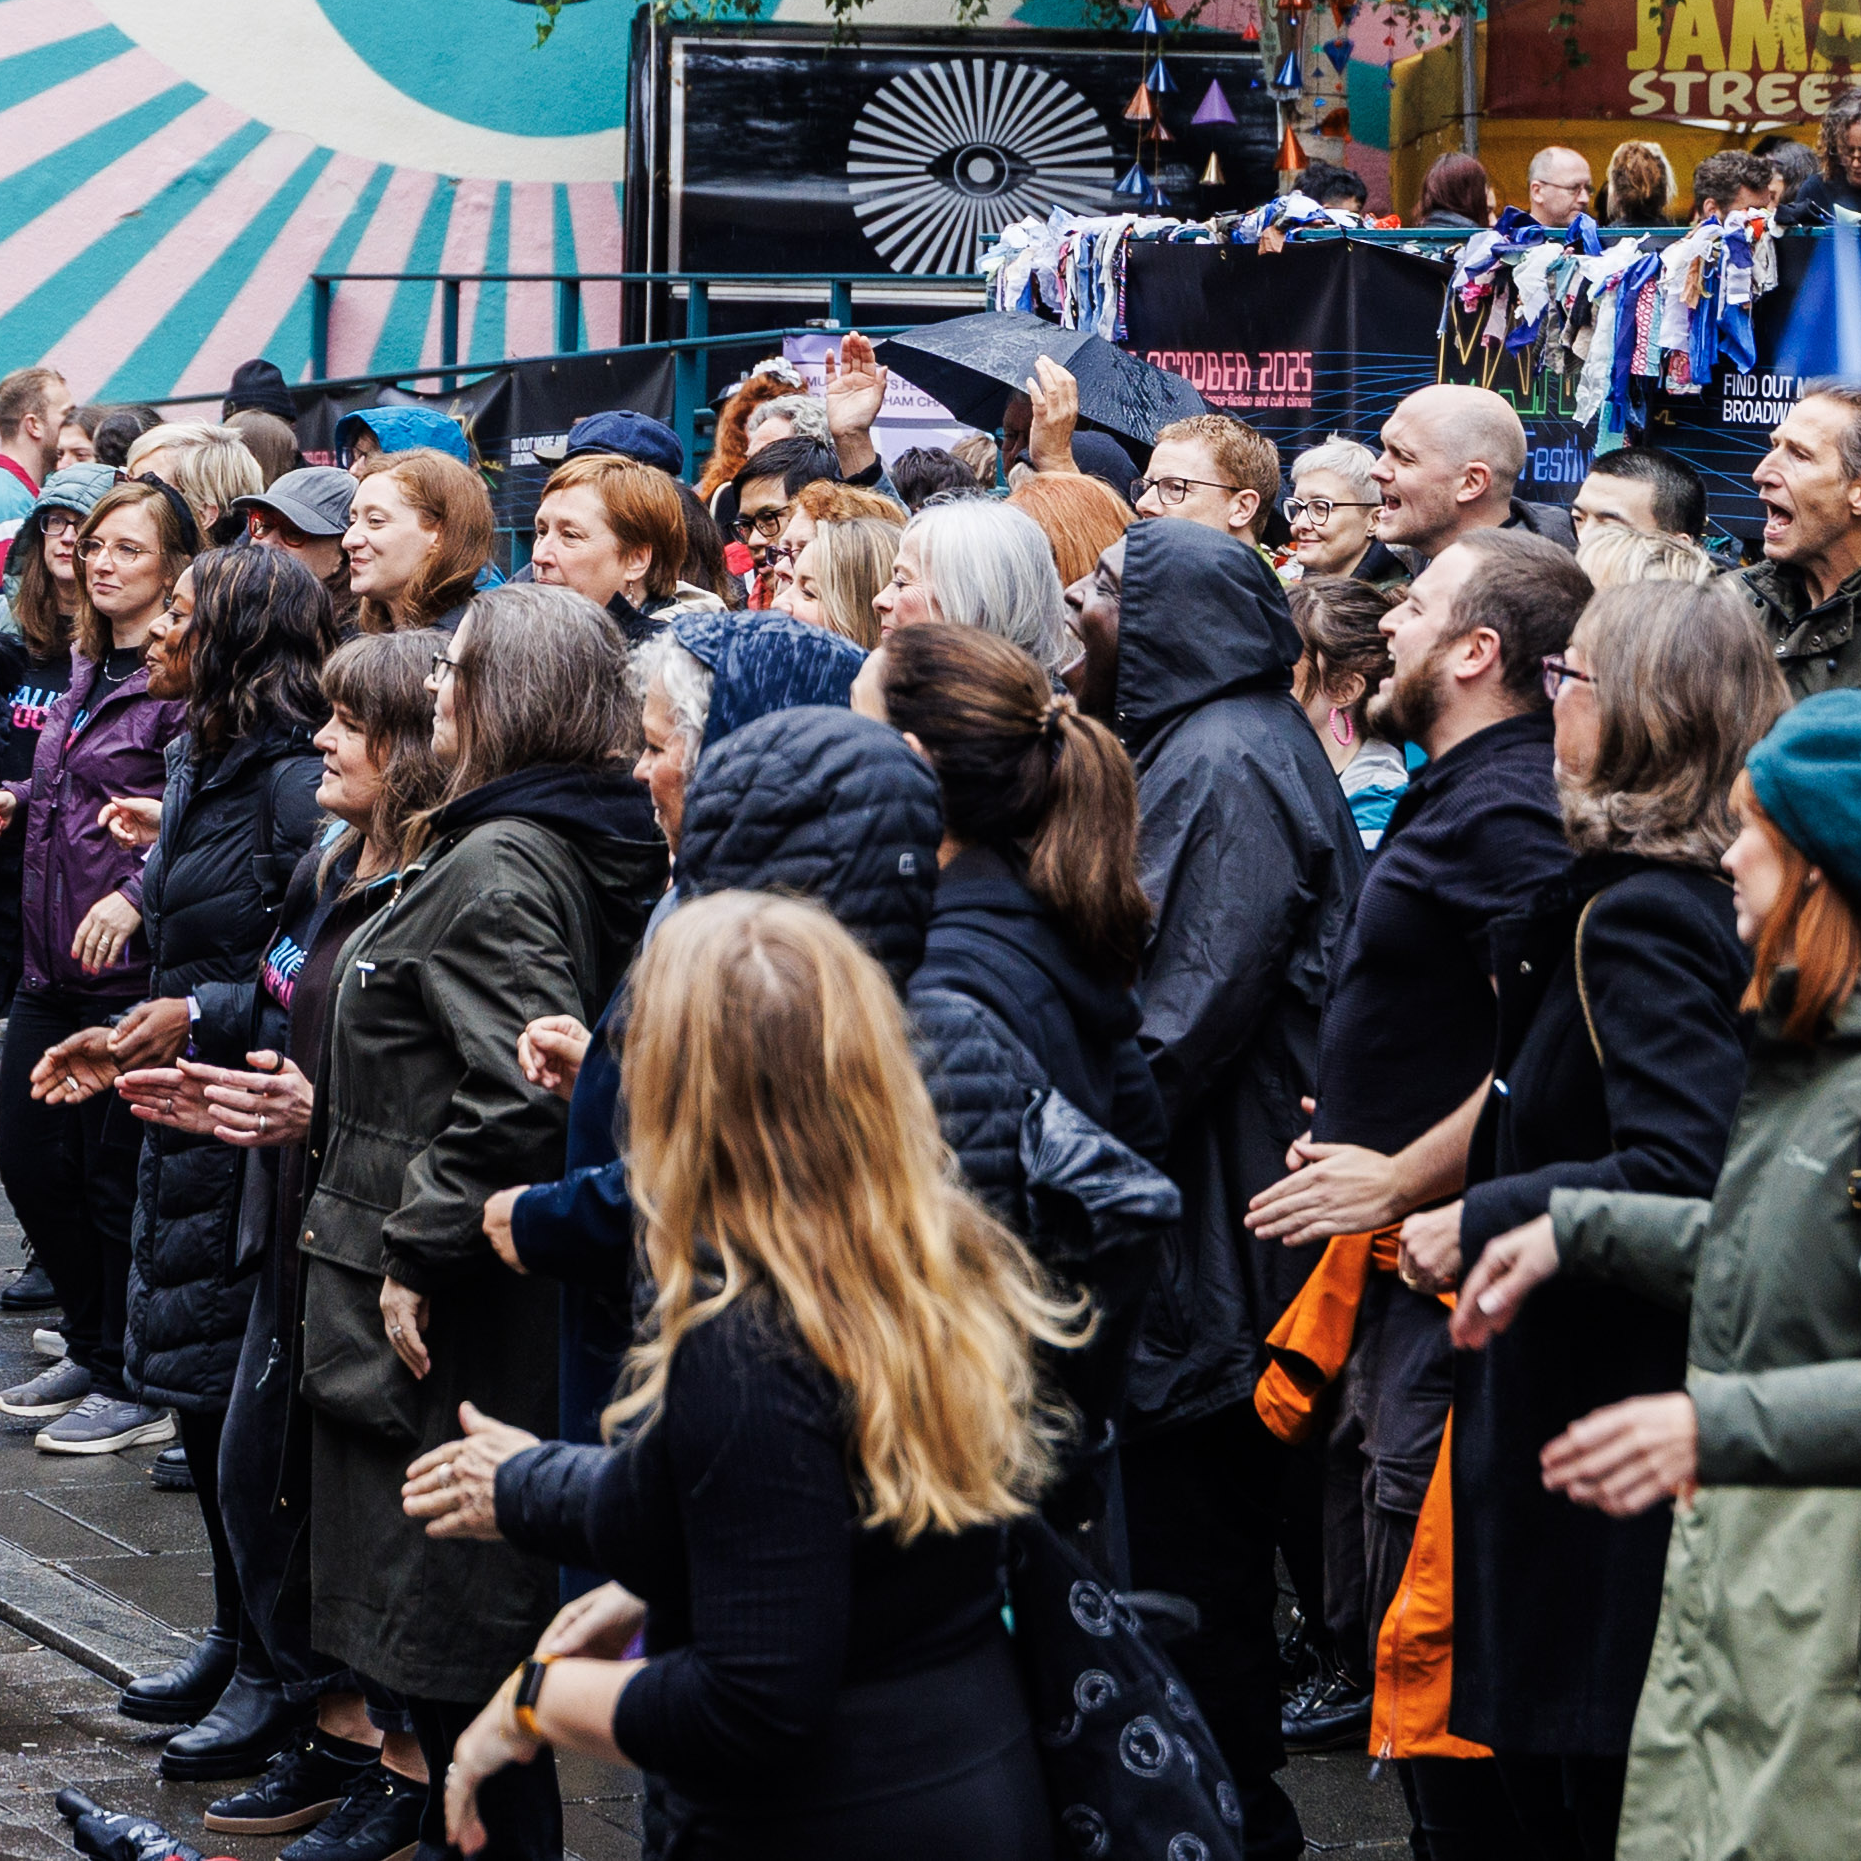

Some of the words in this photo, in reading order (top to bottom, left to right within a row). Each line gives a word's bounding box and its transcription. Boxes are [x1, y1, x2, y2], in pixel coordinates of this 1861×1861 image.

[1258, 351, 1313, 392] 2025
[1723, 373, 1758, 398] FIND
[1761, 375, 1794, 400] OUT
